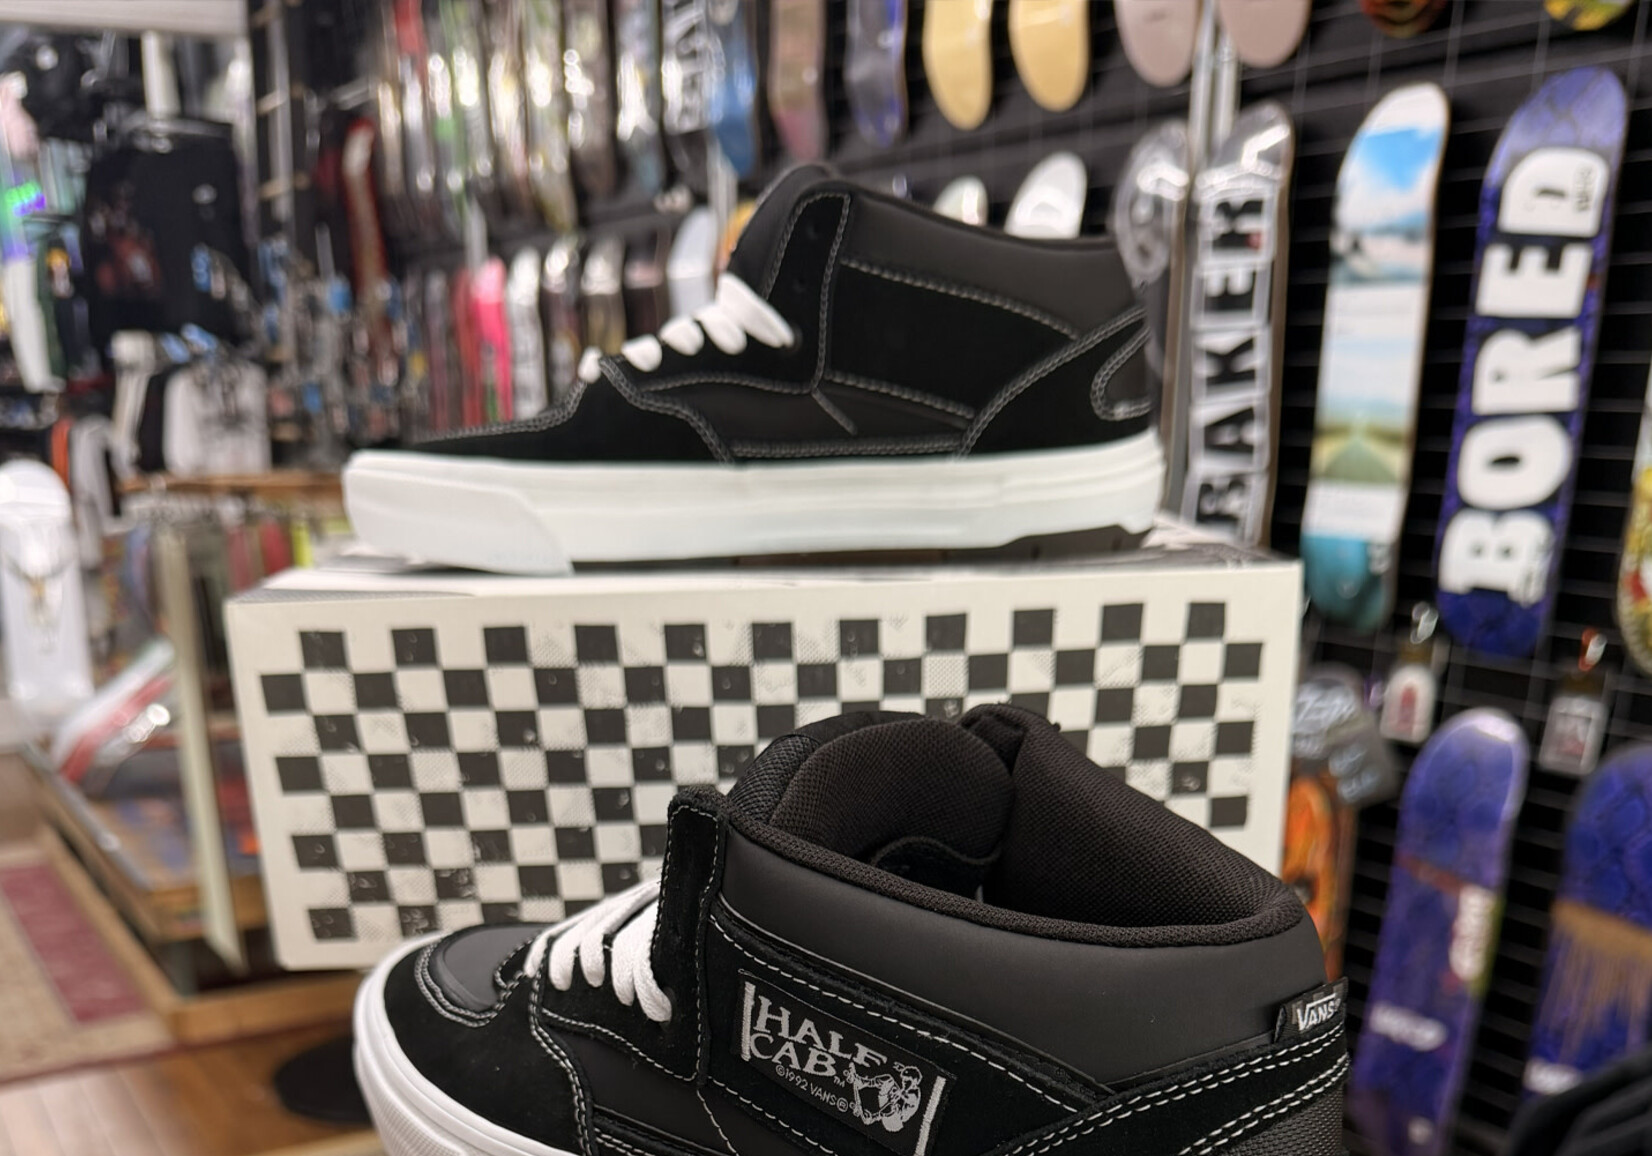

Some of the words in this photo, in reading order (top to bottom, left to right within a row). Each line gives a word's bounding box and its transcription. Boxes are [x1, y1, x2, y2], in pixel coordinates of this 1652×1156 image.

[1194, 198, 1264, 530] BAKER
[1439, 147, 1609, 596] BORED
[752, 995, 888, 1068] HALF
